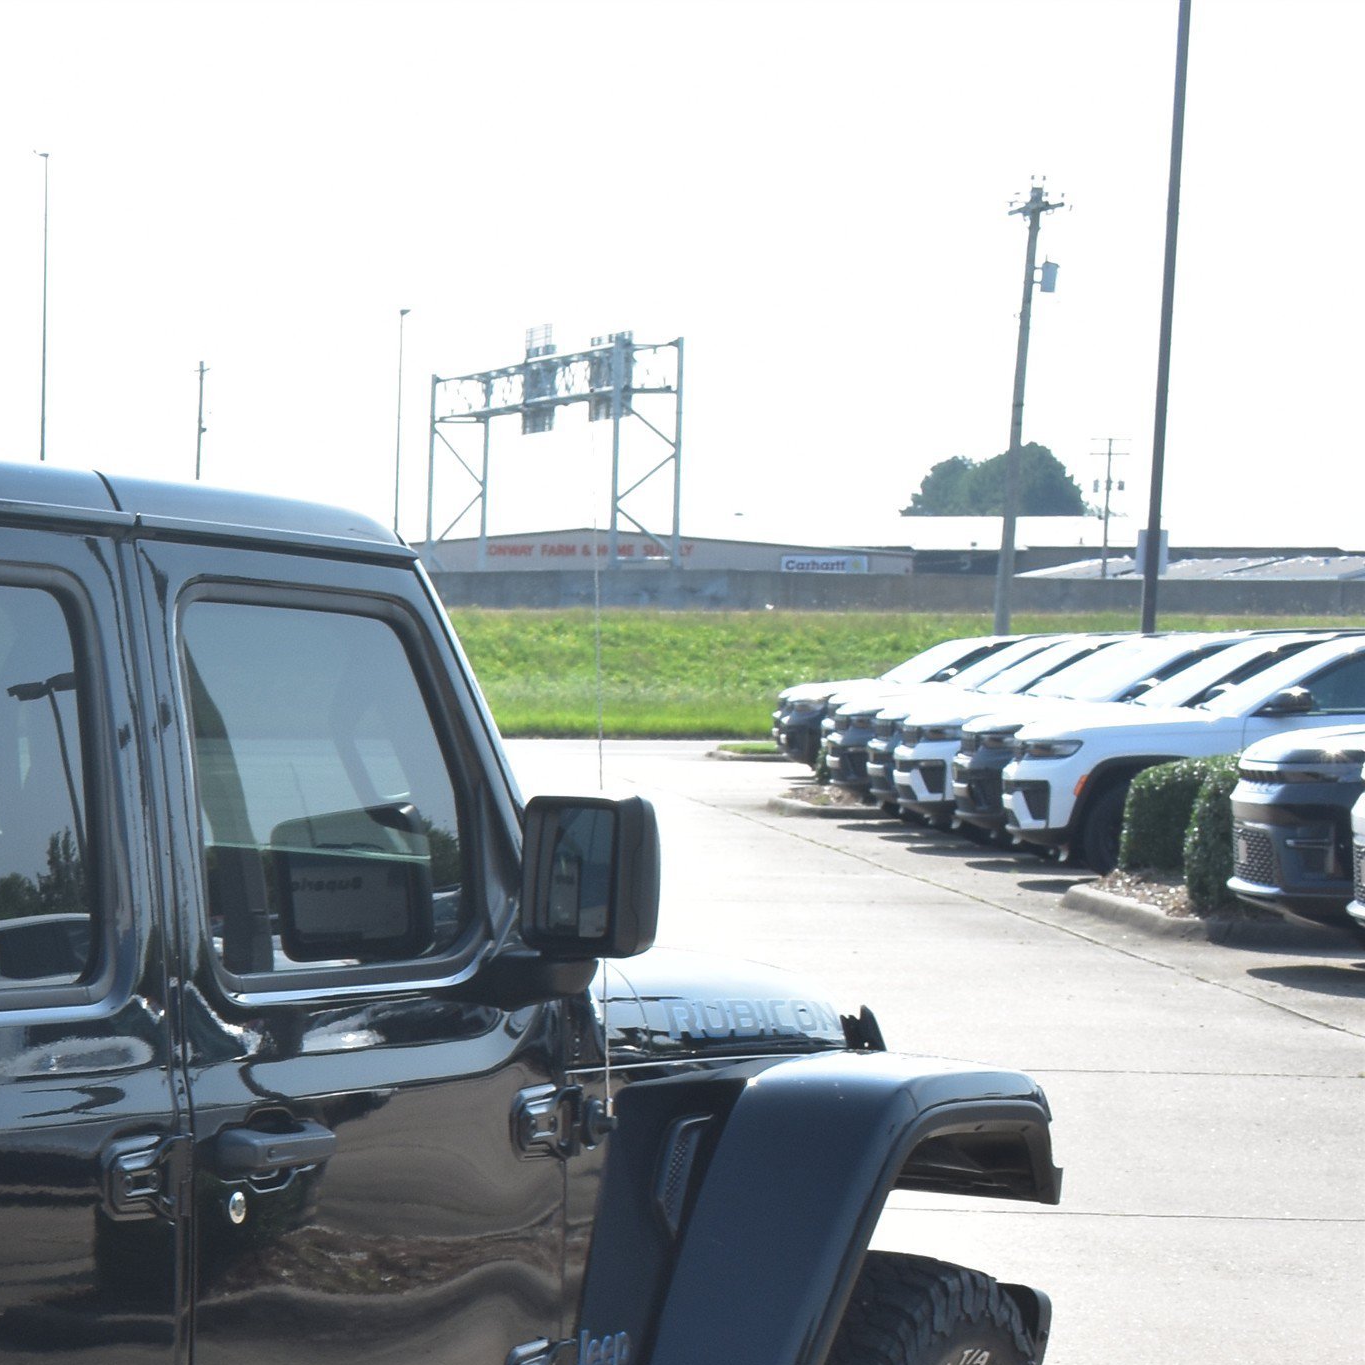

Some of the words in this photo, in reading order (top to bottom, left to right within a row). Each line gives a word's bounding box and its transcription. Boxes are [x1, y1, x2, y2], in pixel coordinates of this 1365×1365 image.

[486, 544, 535, 556] ONWAY
[540, 544, 577, 557] FARM
[582, 544, 592, 556] &
[597, 544, 634, 556] HME
[663, 999, 844, 1040] RUBICON
